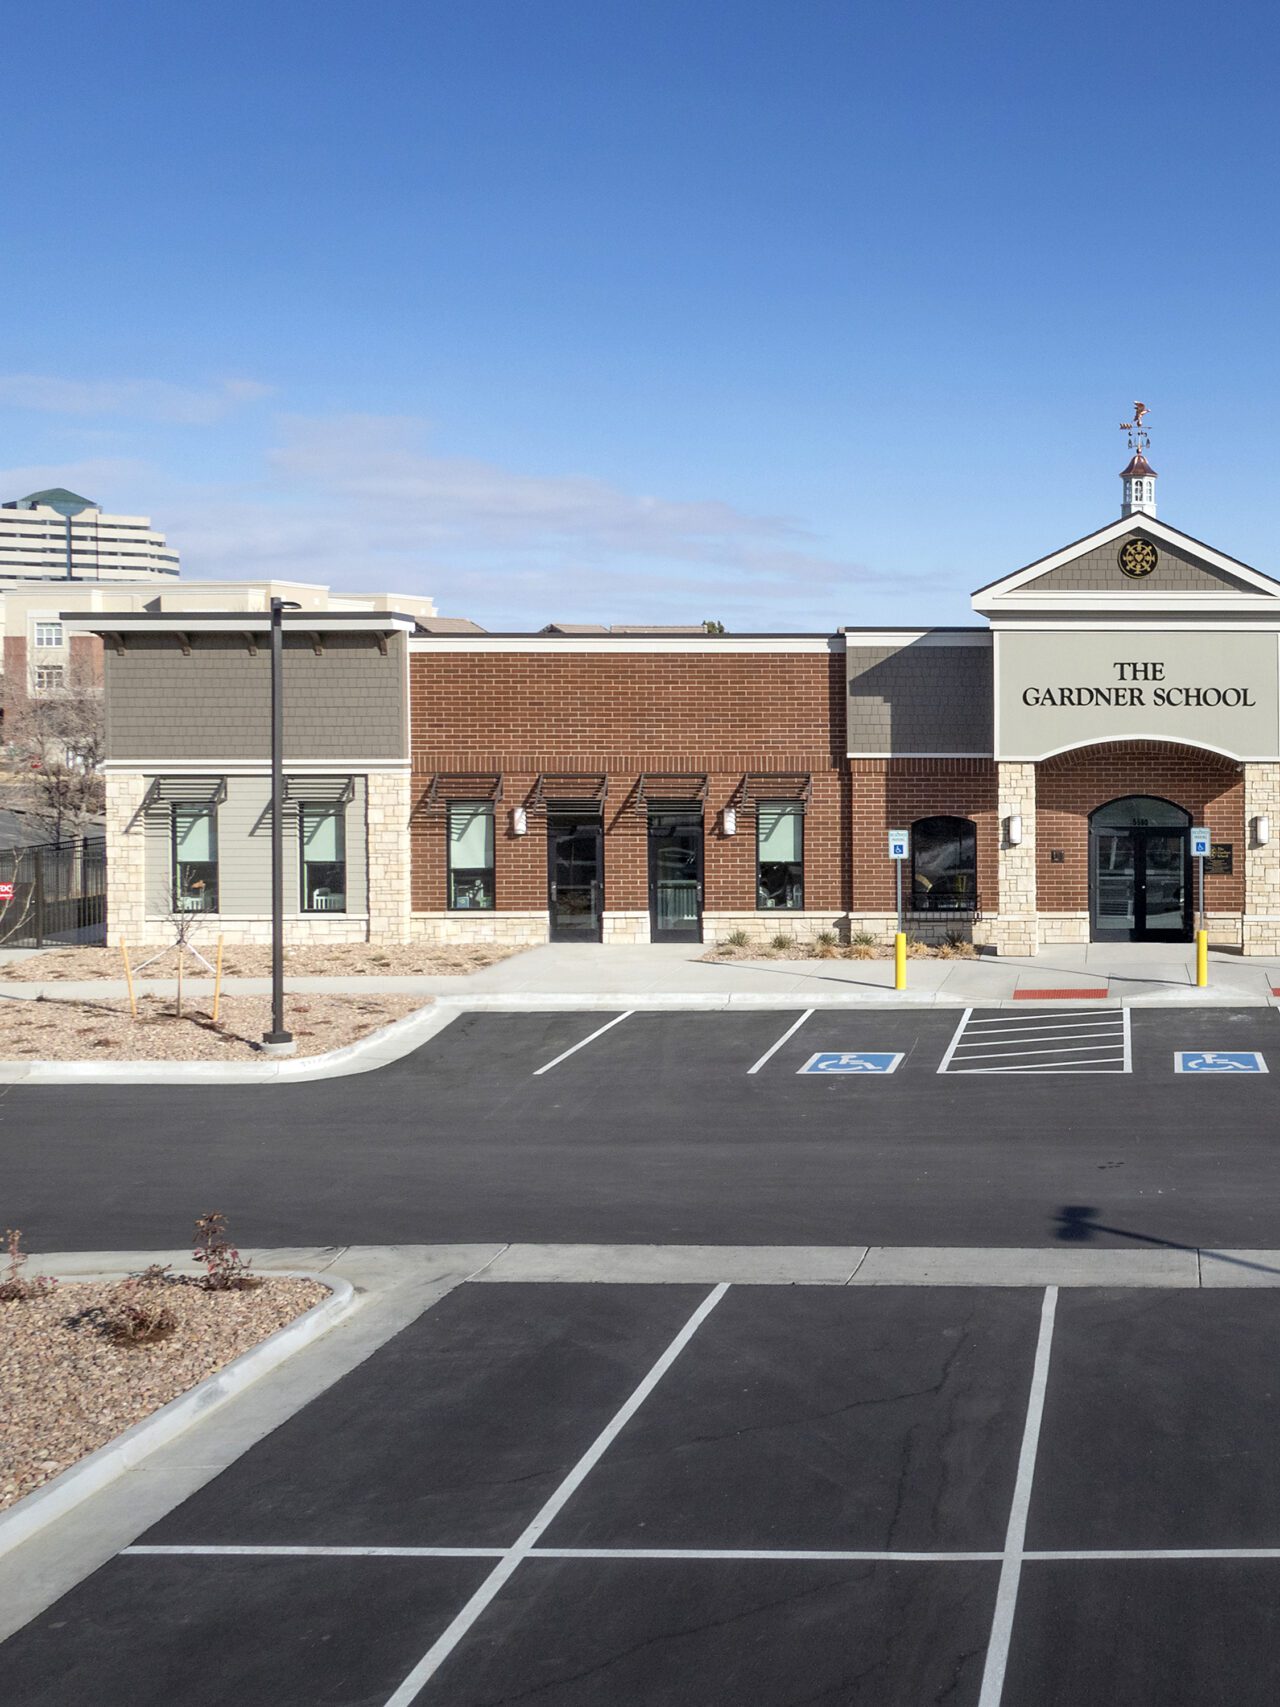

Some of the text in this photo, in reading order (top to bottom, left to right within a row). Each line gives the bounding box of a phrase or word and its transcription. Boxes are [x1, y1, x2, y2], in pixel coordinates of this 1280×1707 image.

[1113, 662, 1165, 681] THE
[1022, 687, 1256, 707] GARDNER SCHOOL
